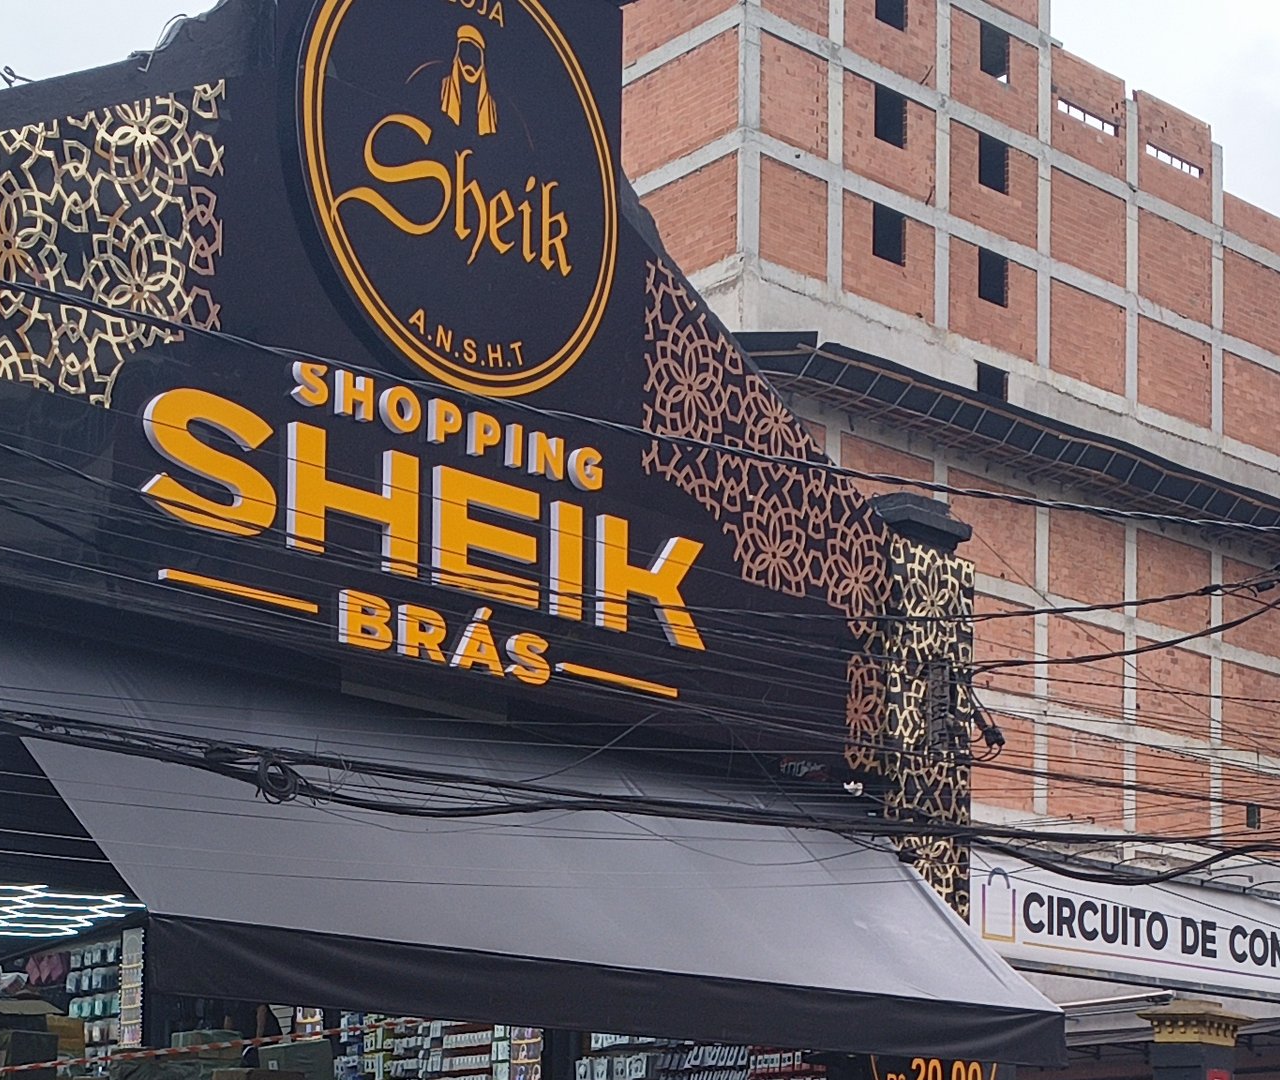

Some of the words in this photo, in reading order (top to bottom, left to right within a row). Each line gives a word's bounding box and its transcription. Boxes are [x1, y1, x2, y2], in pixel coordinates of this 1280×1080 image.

[449, 0, 504, 28] JA
[330, 113, 572, 278] Sheik
[408, 308, 524, 368] A.N.S.H.T
[290, 360, 604, 492] SHOPPING
[140, 387, 707, 652] SHEIK
[338, 588, 552, 687] BRÁS
[1022, 891, 1169, 952] CIRCUITO
[1180, 916, 1217, 960] DE
